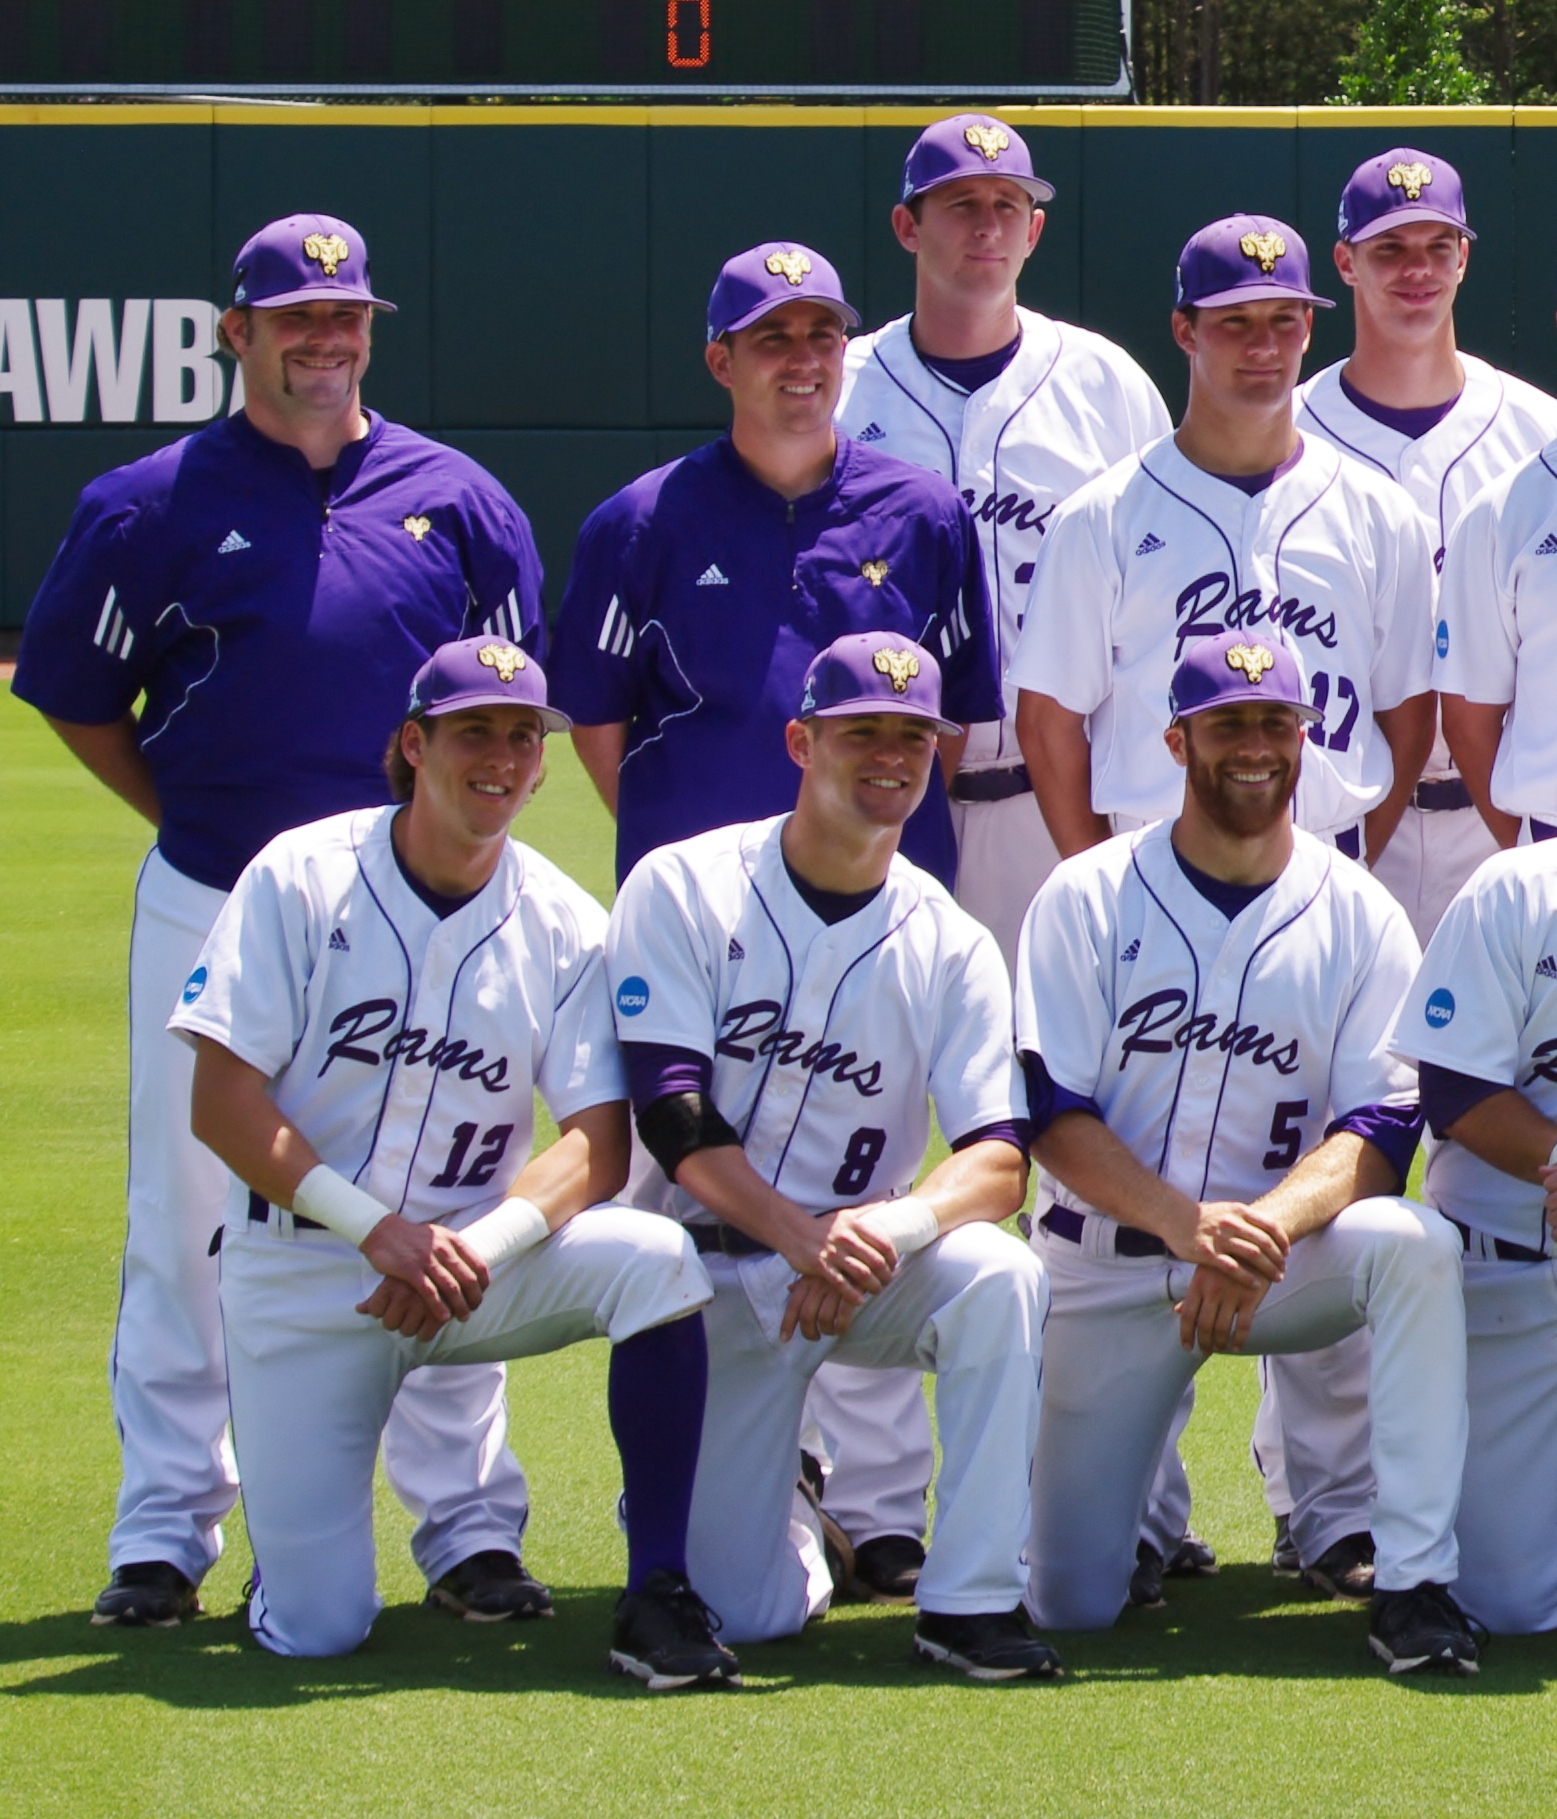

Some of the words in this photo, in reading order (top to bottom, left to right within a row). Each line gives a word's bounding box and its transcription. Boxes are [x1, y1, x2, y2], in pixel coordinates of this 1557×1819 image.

[667, 0, 711, 67] 0
[0, 298, 245, 423] AWB
[218, 541, 251, 554] adidas
[1136, 541, 1166, 556] adidas
[1174, 571, 1338, 662] Rams
[1307, 671, 1359, 753] 17
[620, 995, 646, 1007] NCAA
[1118, 988, 1300, 1076] Rams
[1427, 1005, 1452, 1021] NCAA
[318, 998, 511, 1093] Rams
[716, 1000, 884, 1097] Rams
[429, 1121, 515, 1188] 12
[831, 1127, 887, 1196] 8
[1263, 1099, 1310, 1170] 5
